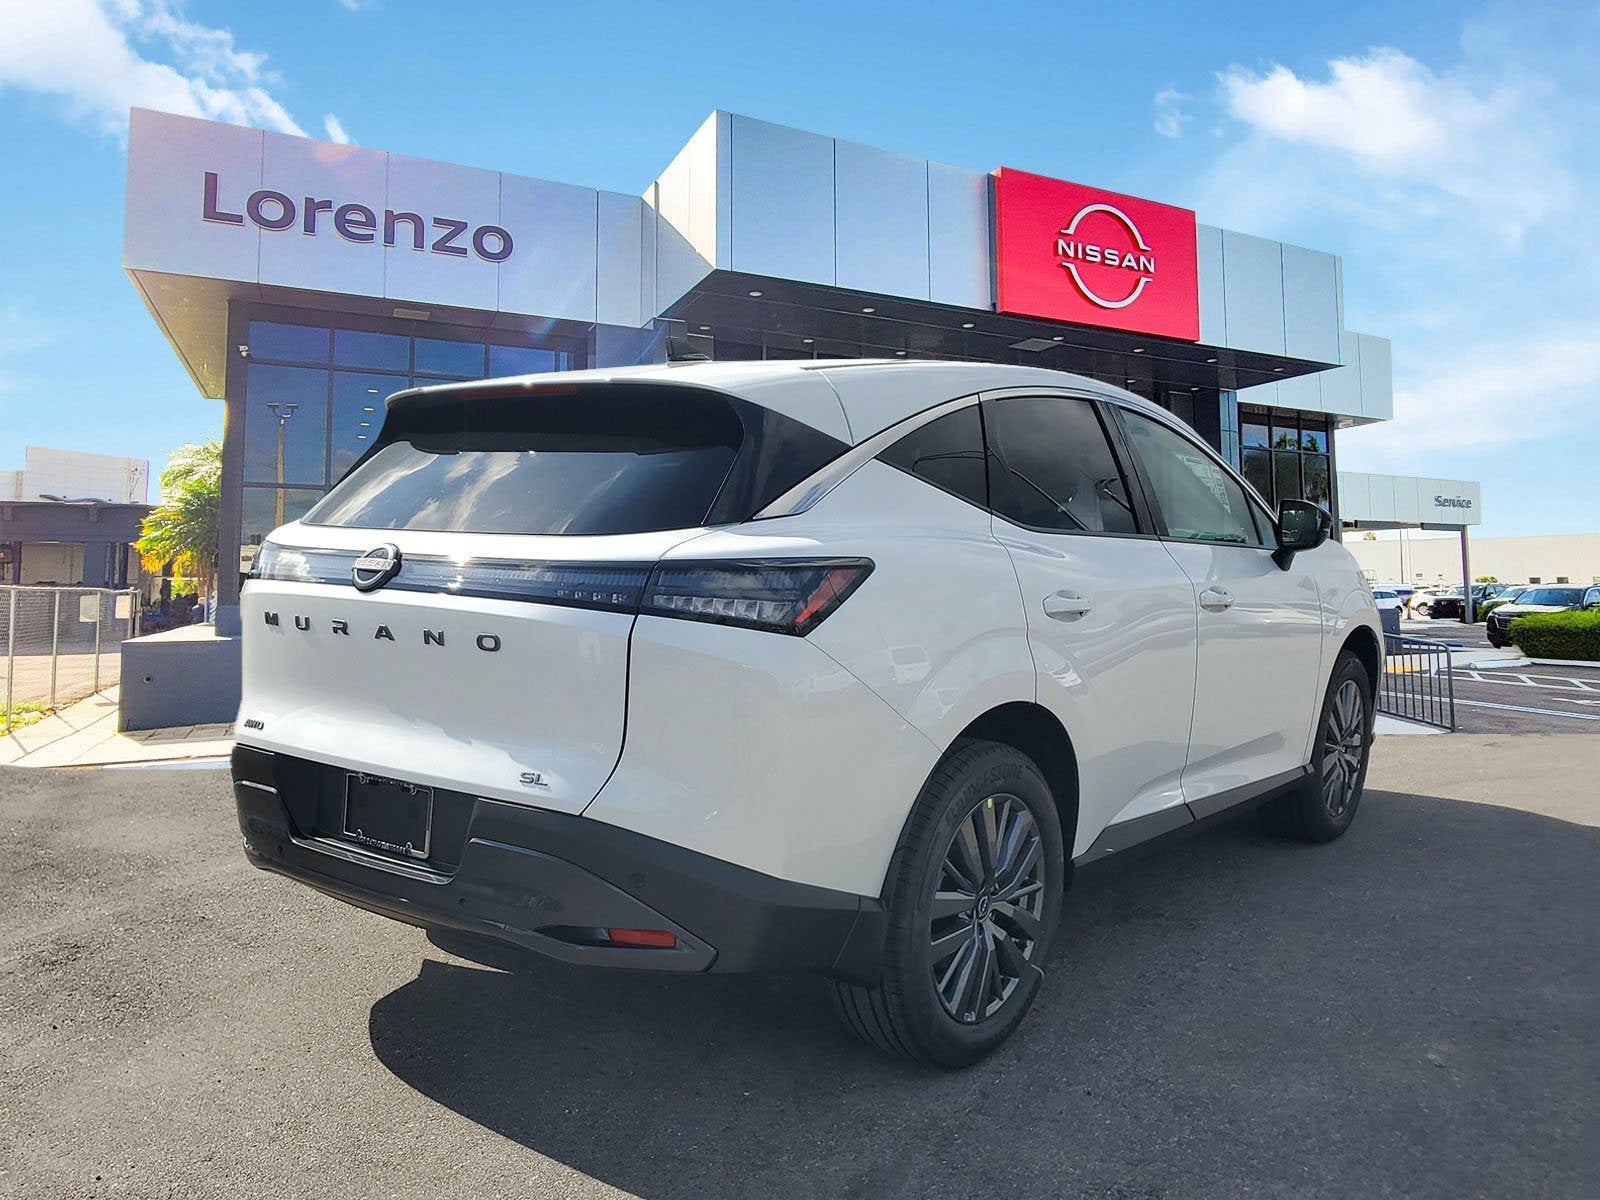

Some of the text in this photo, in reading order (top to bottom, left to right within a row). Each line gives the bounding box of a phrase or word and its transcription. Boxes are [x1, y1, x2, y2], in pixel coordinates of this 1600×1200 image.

[203, 171, 514, 262] Lorenzo
[1058, 238, 1155, 273] NISSAN
[1434, 495, 1472, 509] Service
[264, 611, 502, 652] MURANO
[244, 719, 265, 730] AWD
[519, 772, 548, 786] SL
